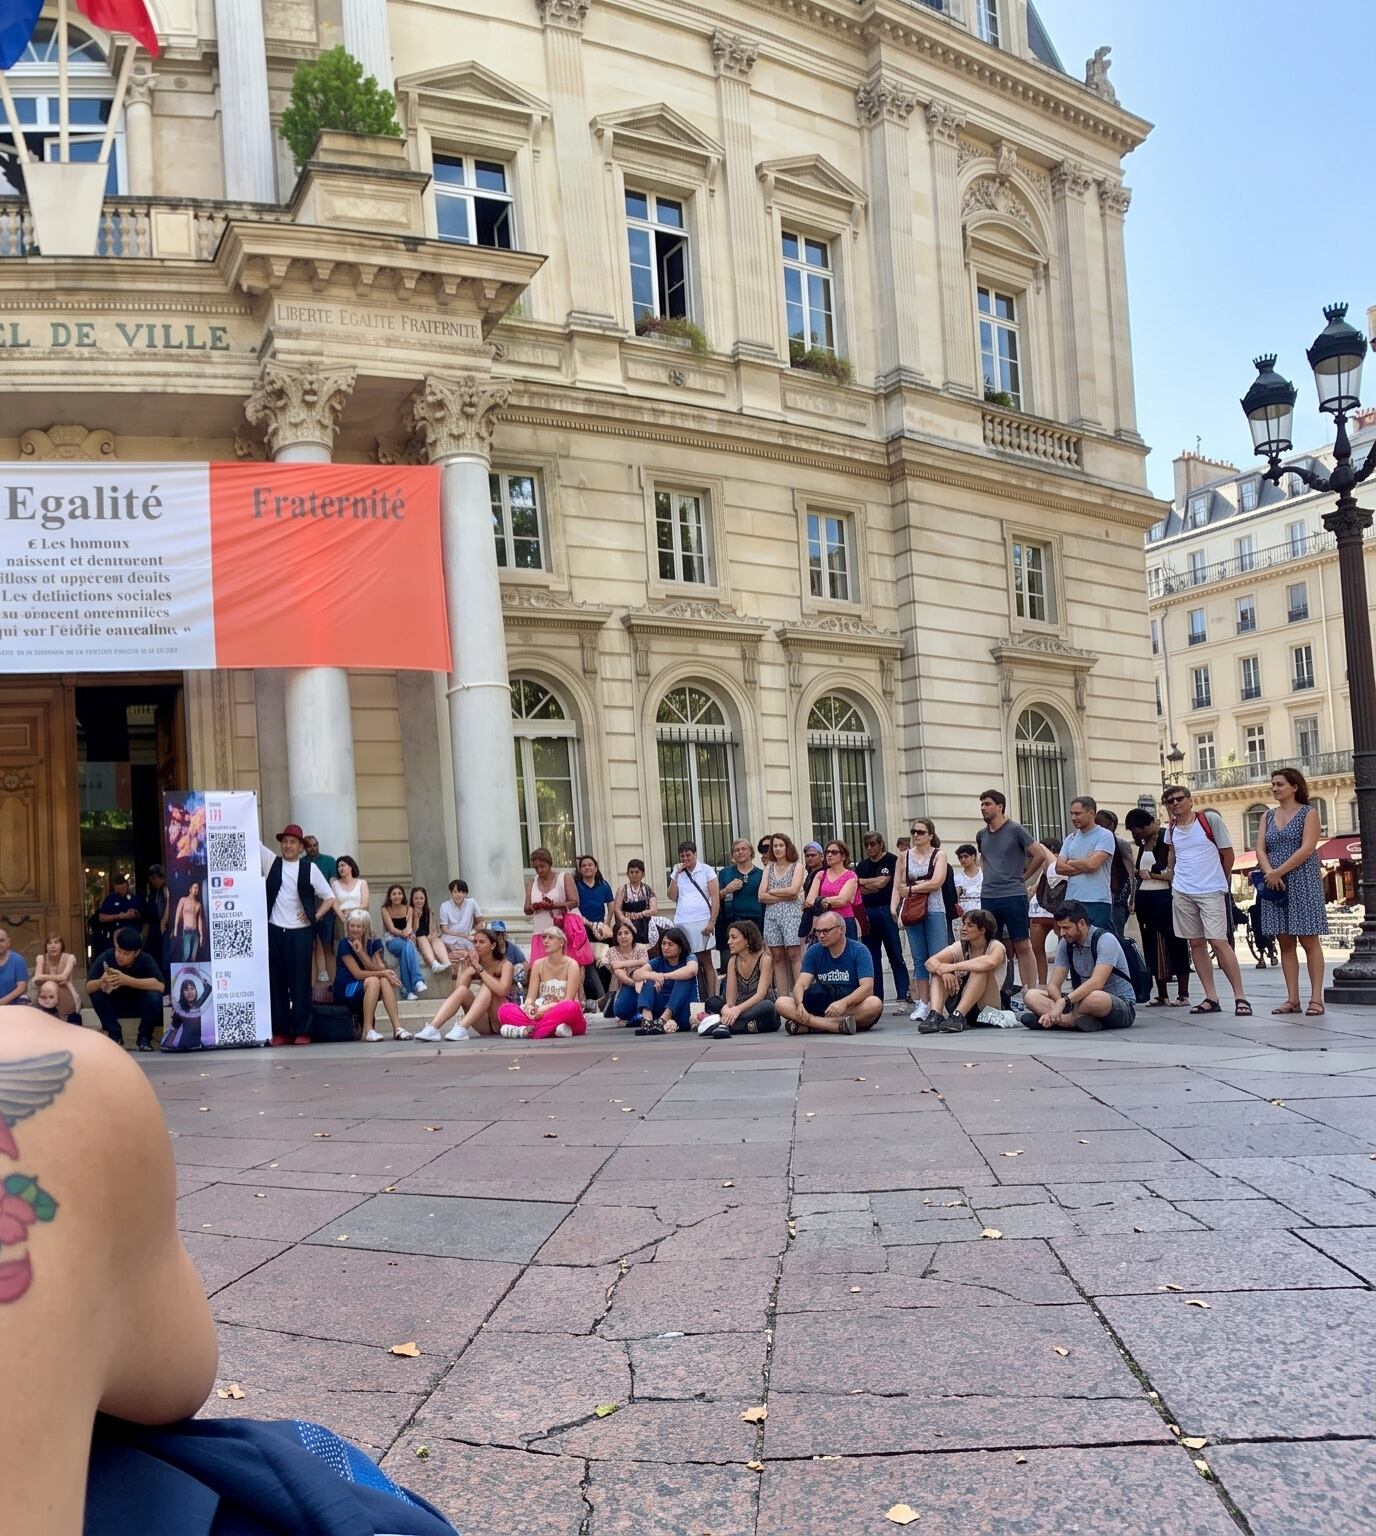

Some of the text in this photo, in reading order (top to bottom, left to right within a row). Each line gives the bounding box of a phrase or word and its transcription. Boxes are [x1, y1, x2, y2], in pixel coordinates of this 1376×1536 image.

[277, 303, 479, 340] LIBERTE EGALITE FRATERNITE
[50, 322, 97, 347] DE
[115, 322, 231, 351] VILLE
[3, 484, 164, 531] Egalité
[252, 487, 406, 520] Fraternité
[41, 537, 66, 550] Les
[6, 555, 65, 567] naissent
[70, 555, 83, 567] et
[2, 589, 27, 602] Les
[117, 588, 172, 602] sociales
